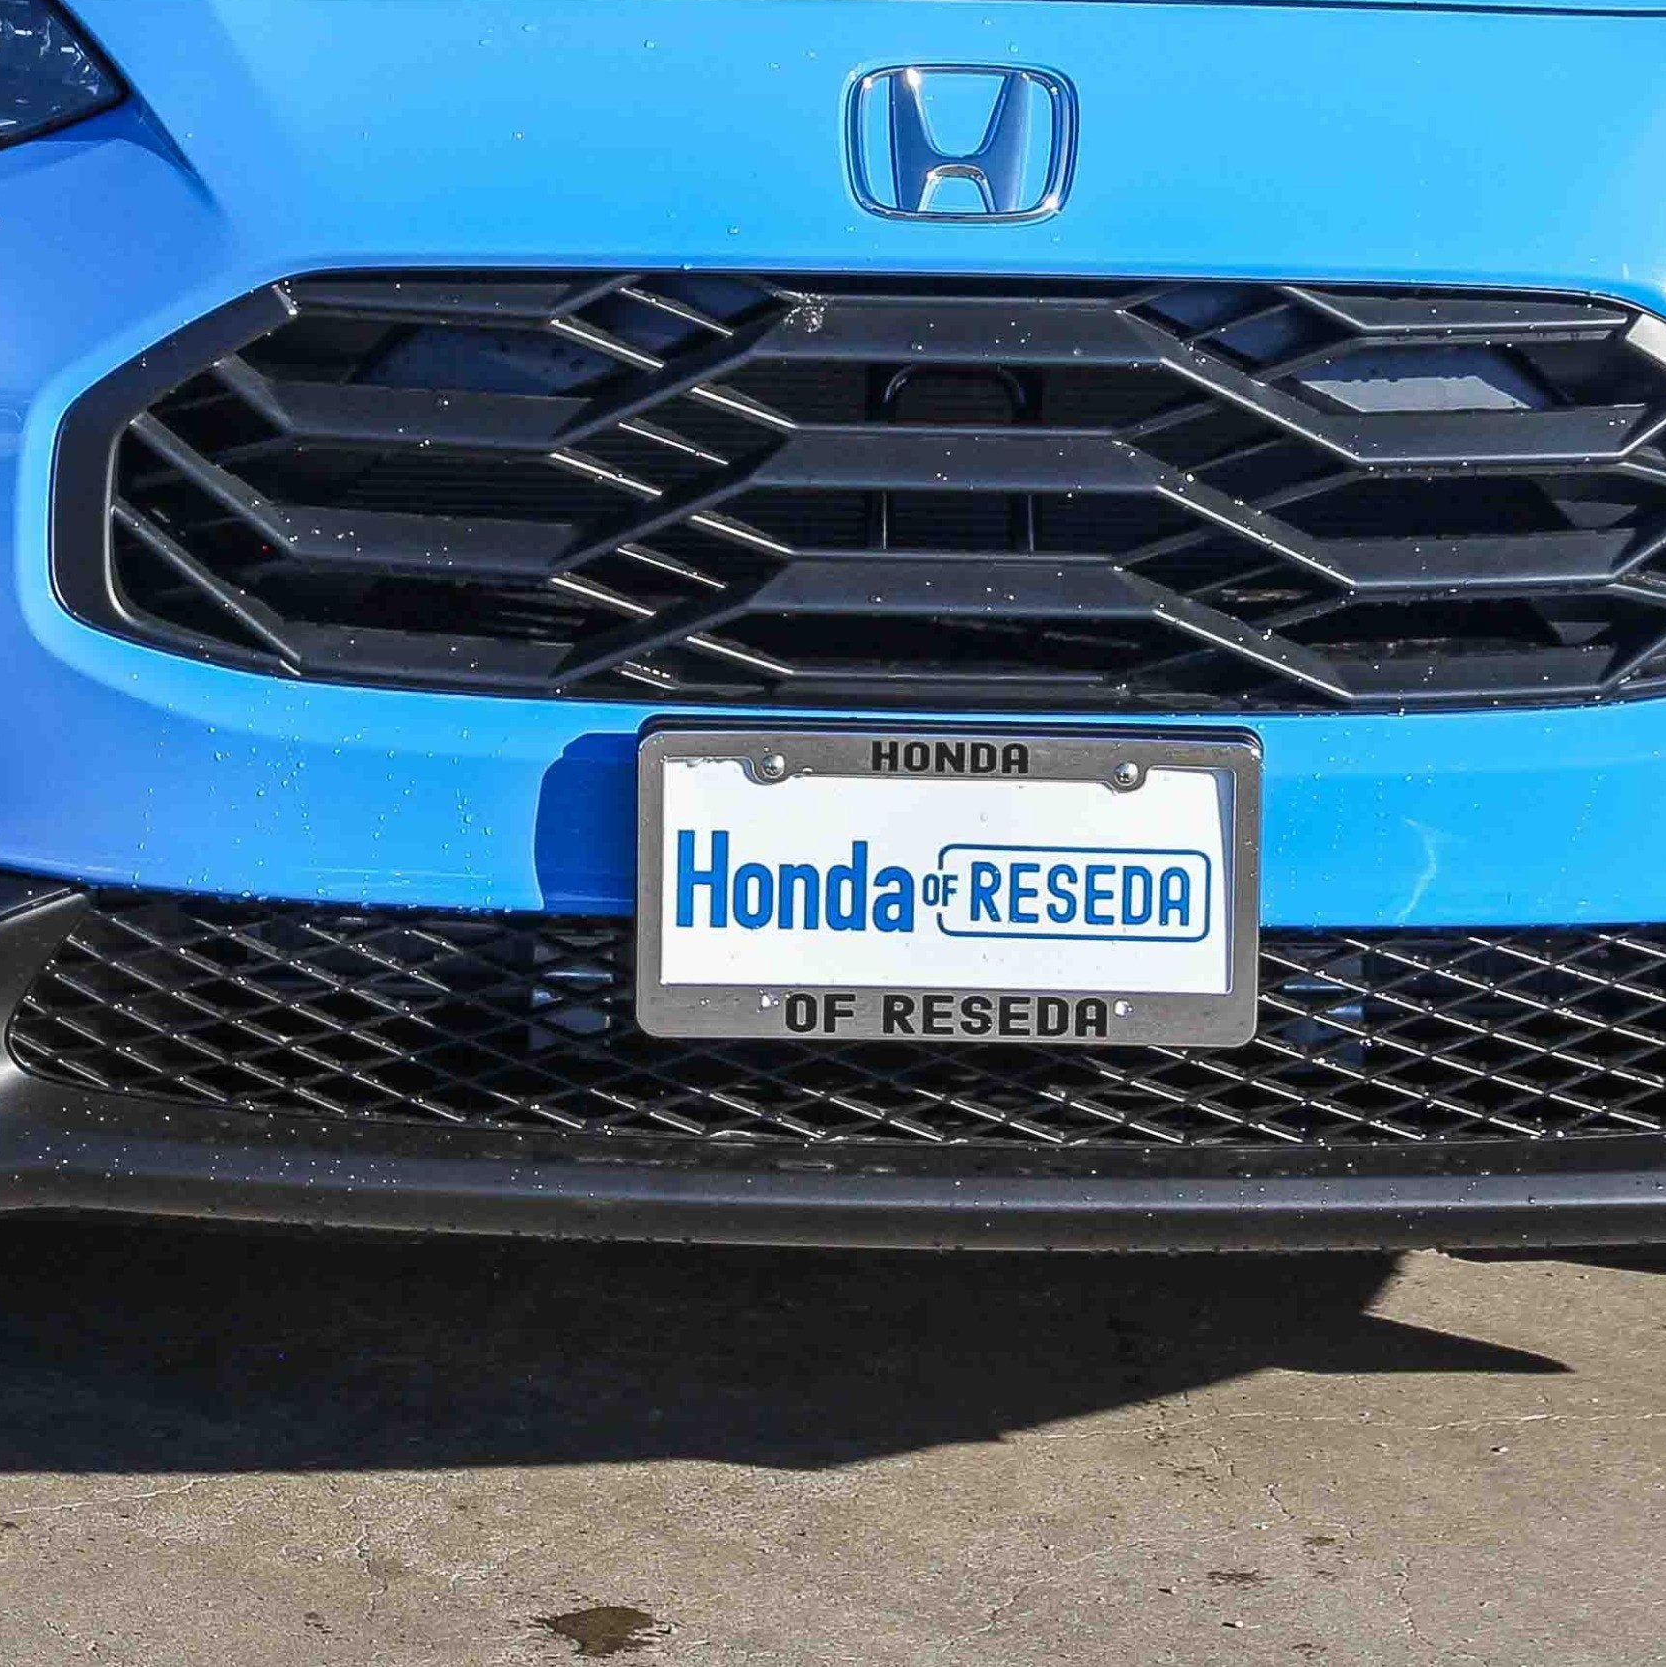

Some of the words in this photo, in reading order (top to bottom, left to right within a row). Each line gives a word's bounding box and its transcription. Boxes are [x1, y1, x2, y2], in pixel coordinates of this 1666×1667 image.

[871, 741, 1030, 775] HONDA
[676, 829, 915, 933] Honda
[922, 873, 958, 907] OF
[970, 861, 1191, 927] RESEDA
[784, 993, 856, 1034] OF
[882, 994, 1108, 1038] RESEDA
